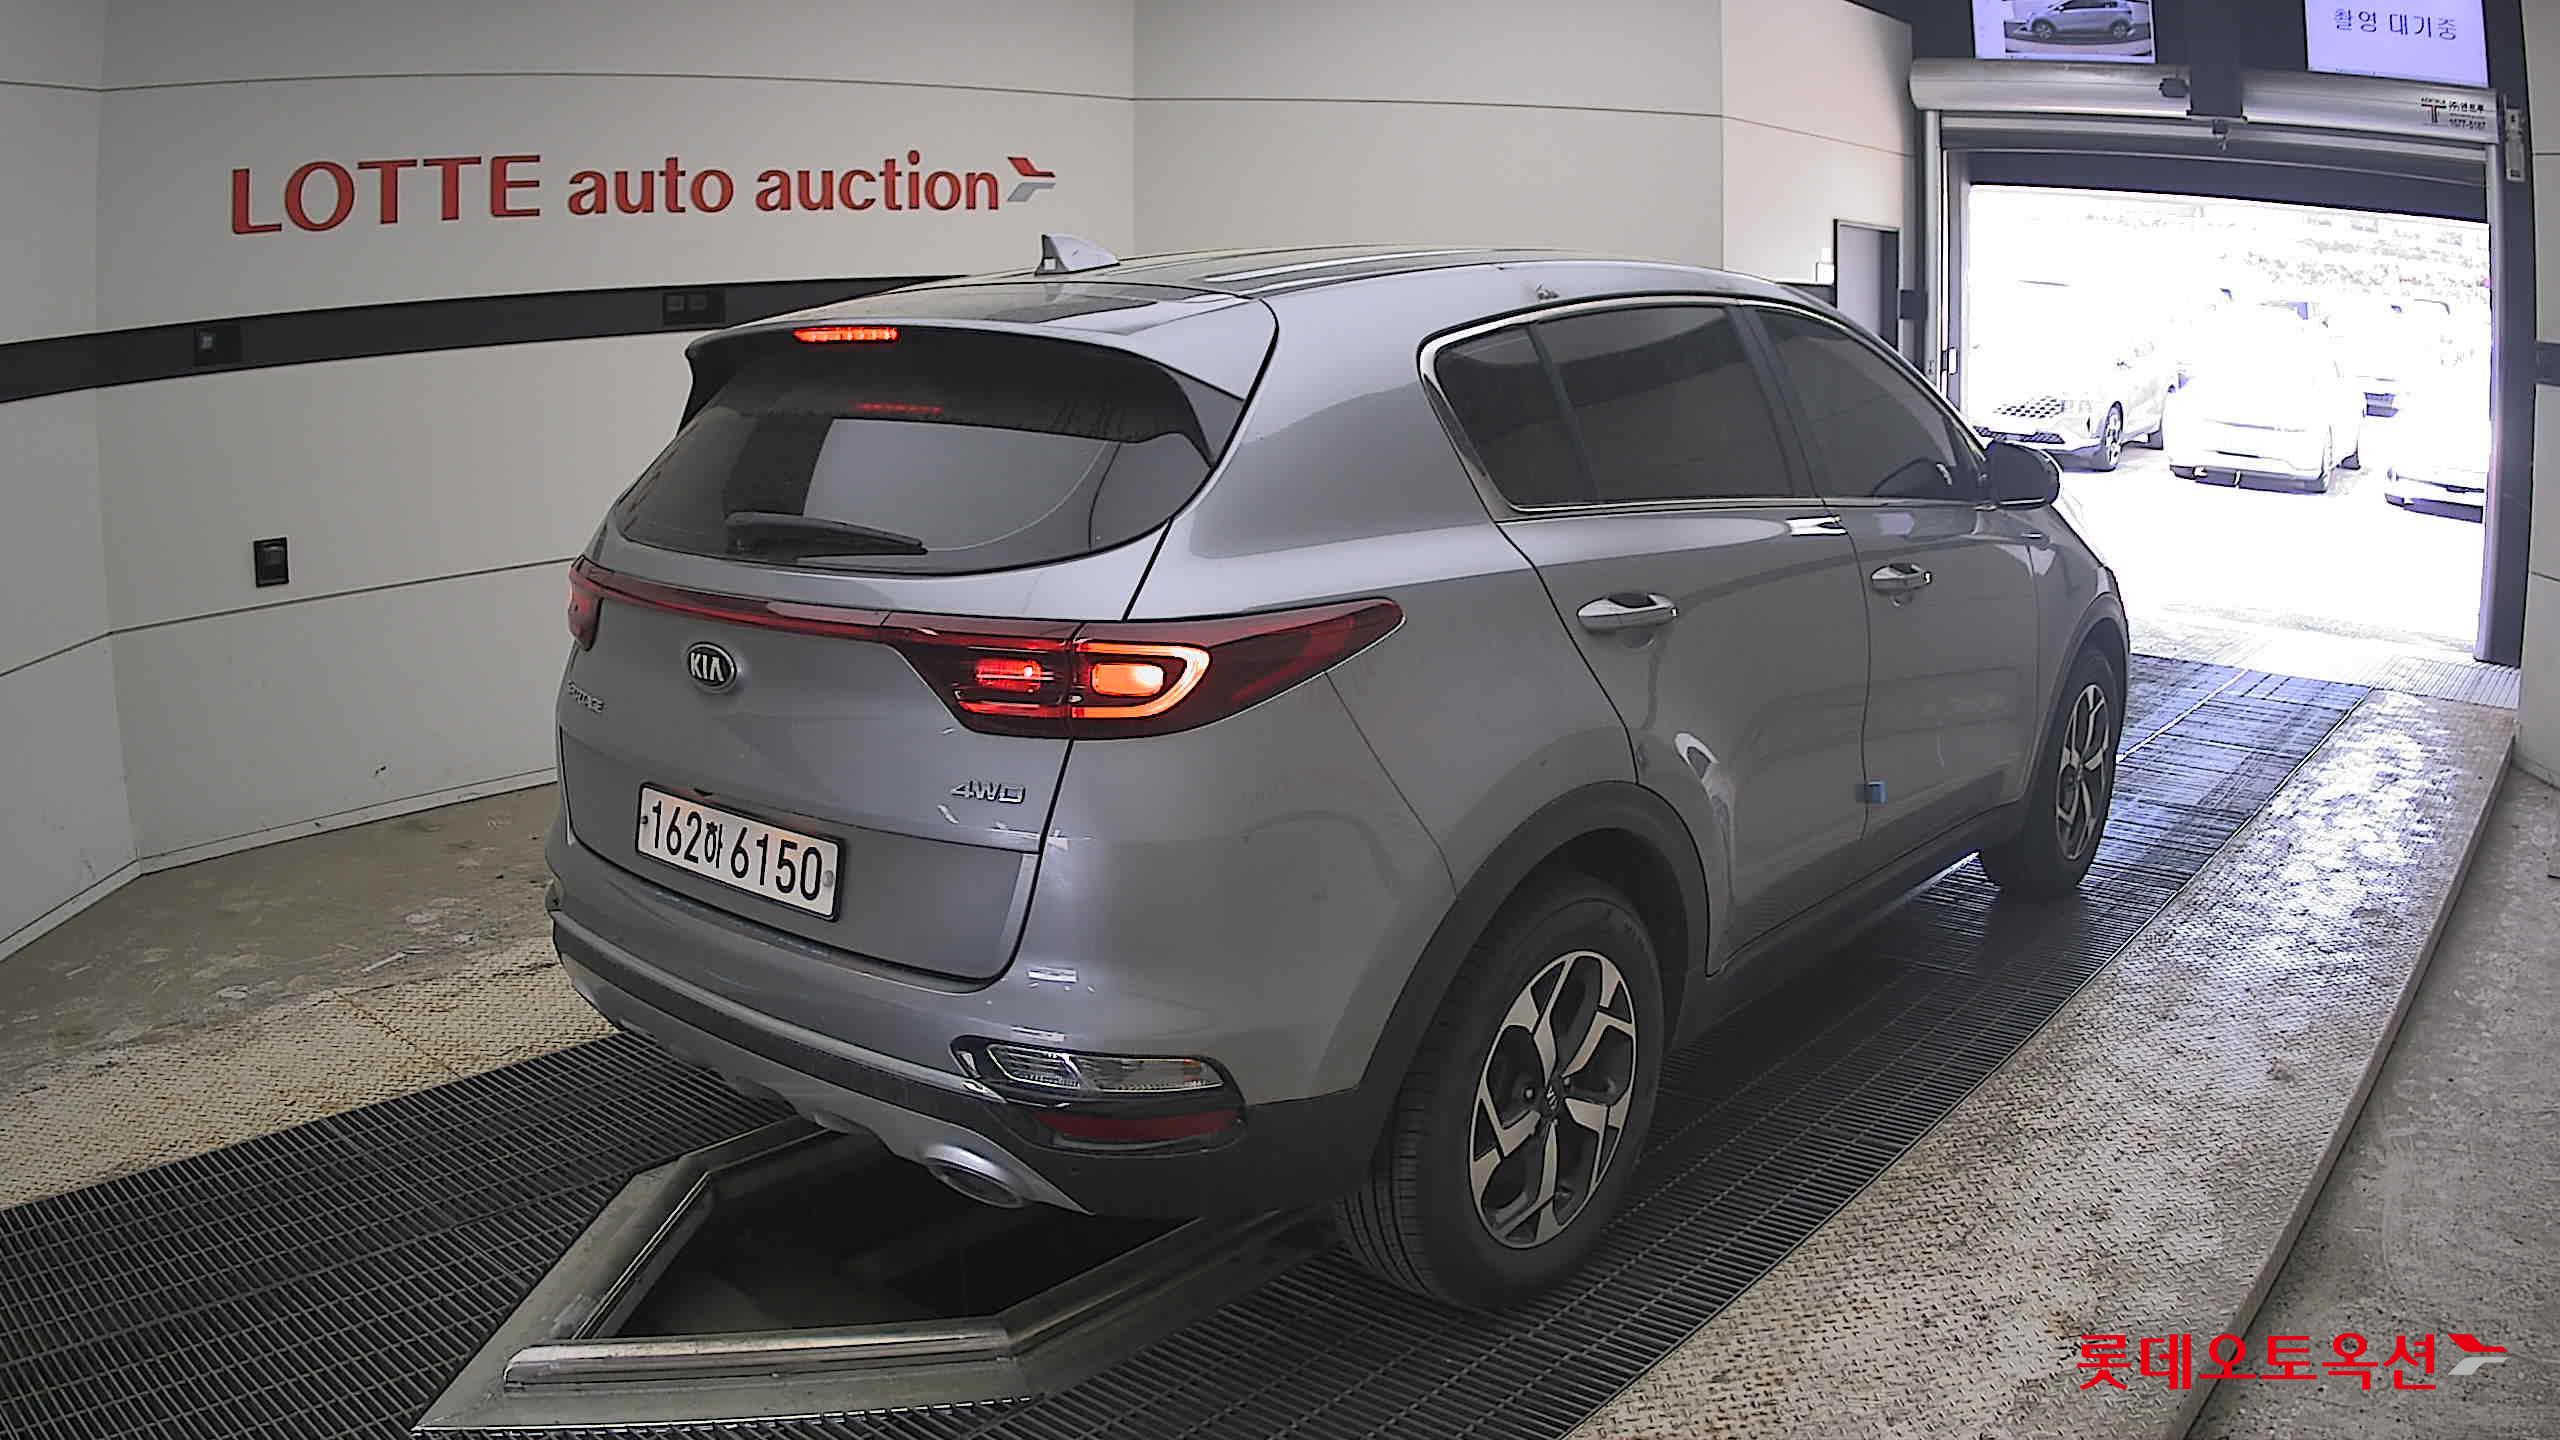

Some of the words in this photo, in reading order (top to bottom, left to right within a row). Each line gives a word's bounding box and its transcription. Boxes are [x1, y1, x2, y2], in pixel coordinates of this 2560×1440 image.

[2389, 13, 2457, 41] 대기중
[233, 154, 541, 234] LOTTE
[568, 157, 734, 214] auto
[755, 150, 1001, 212] auction
[688, 650, 723, 683] KIA
[950, 779, 1026, 805] 4WD
[650, 799, 823, 903] 162하6150
